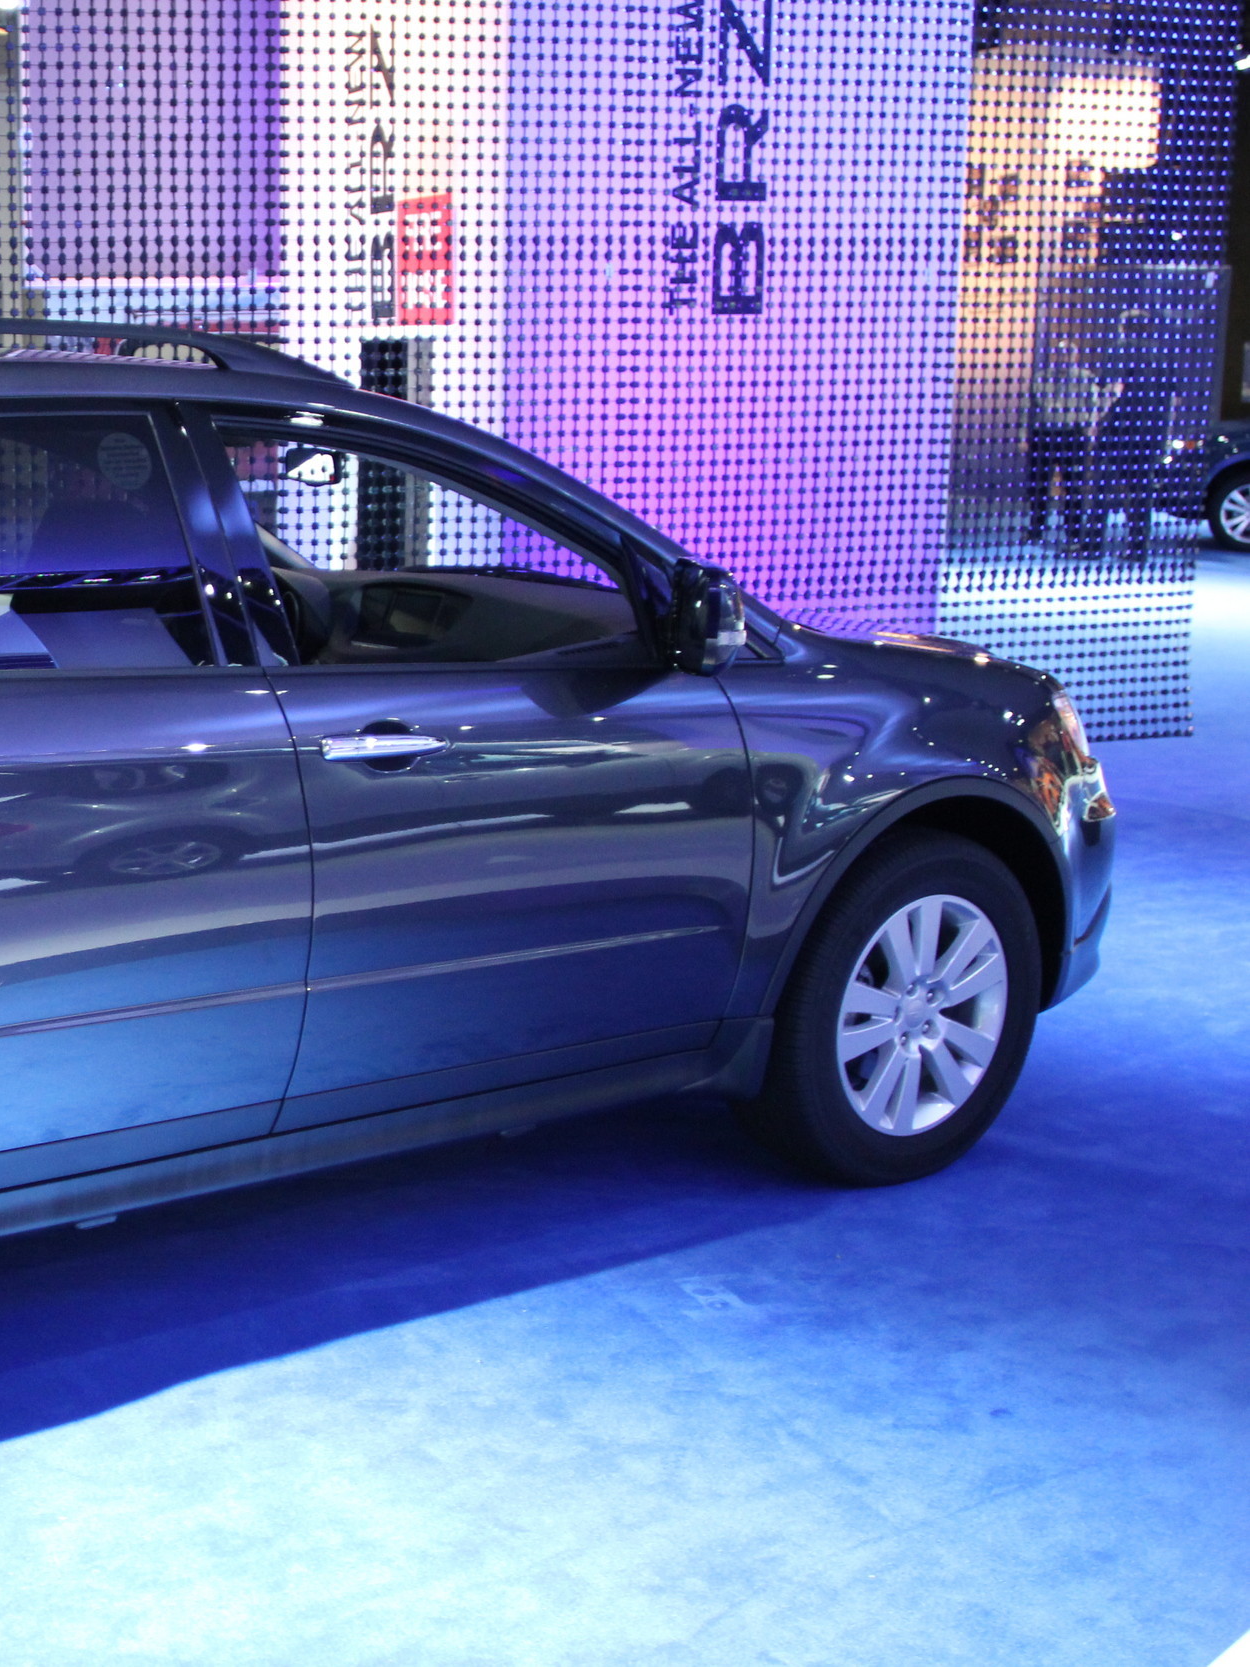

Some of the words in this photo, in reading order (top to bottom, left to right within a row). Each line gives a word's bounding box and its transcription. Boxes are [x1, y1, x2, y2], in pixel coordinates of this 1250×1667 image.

[370, 17, 395, 319] BRZ
[670, 0, 705, 207] ALL-NEW
[711, 0, 771, 315] BRZ
[665, 222, 699, 315] THE
